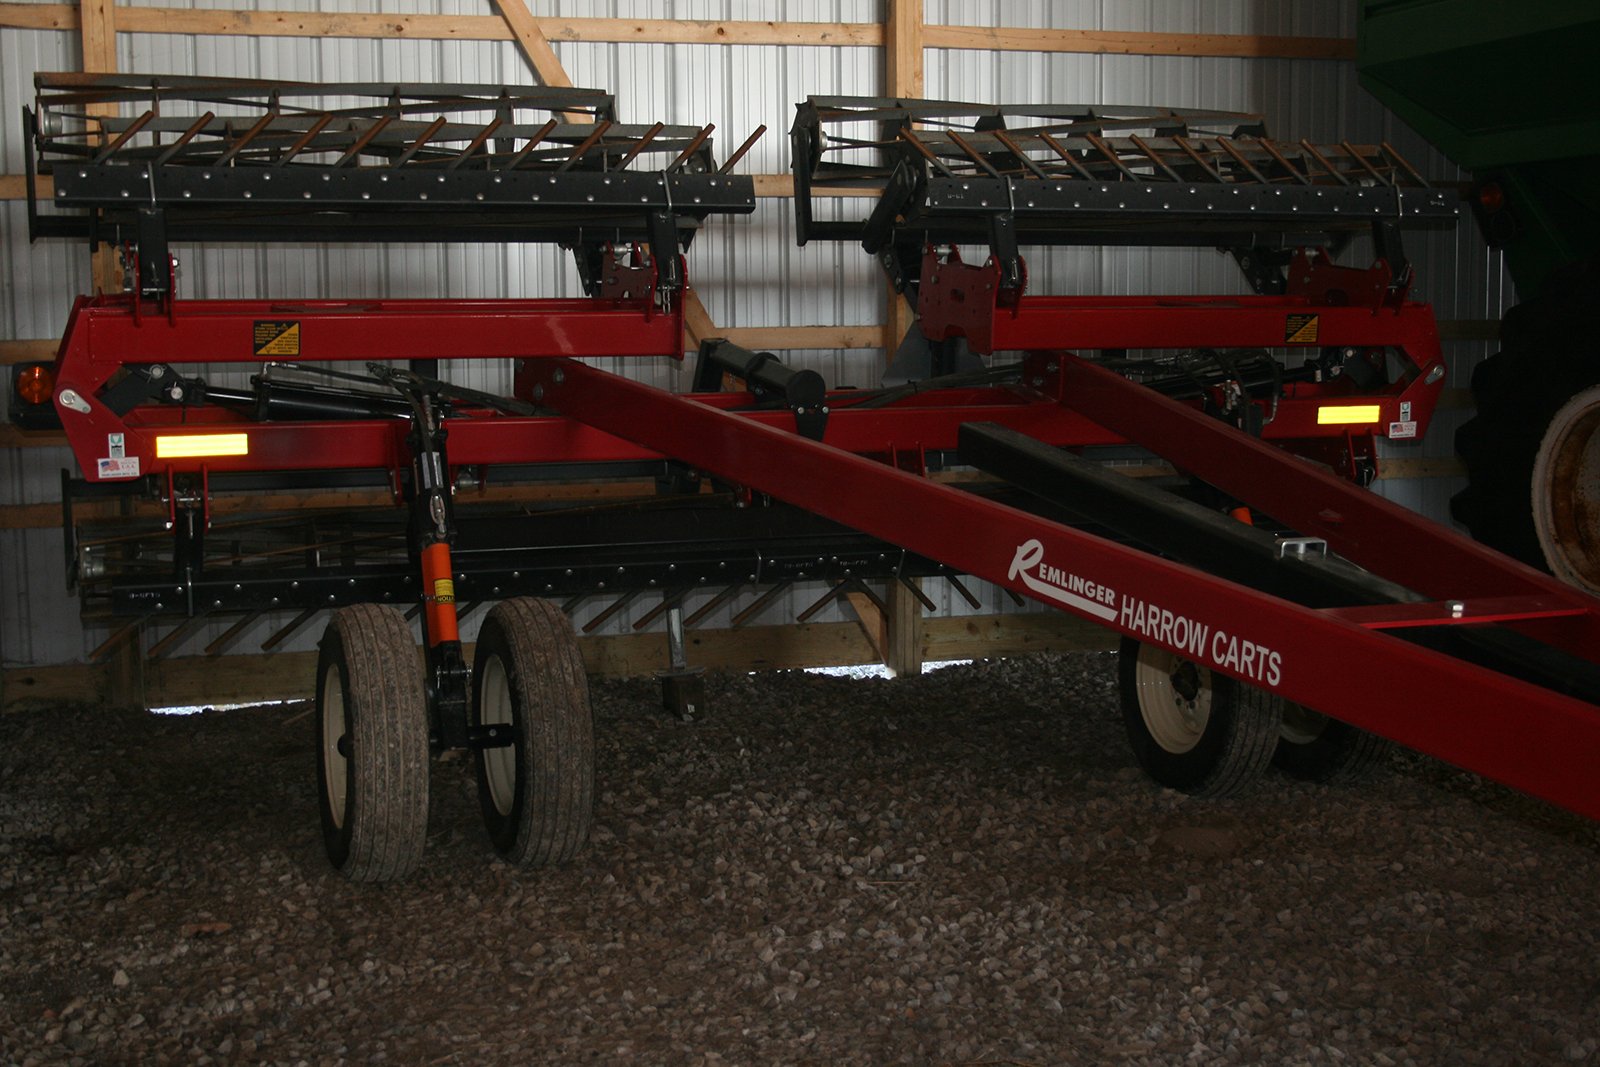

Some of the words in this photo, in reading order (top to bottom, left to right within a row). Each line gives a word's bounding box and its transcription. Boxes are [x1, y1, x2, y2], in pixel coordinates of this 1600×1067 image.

[1008, 539, 1118, 621] REMLINGER
[1121, 594, 1208, 657] HARROW
[1212, 631, 1282, 686] CARTS
